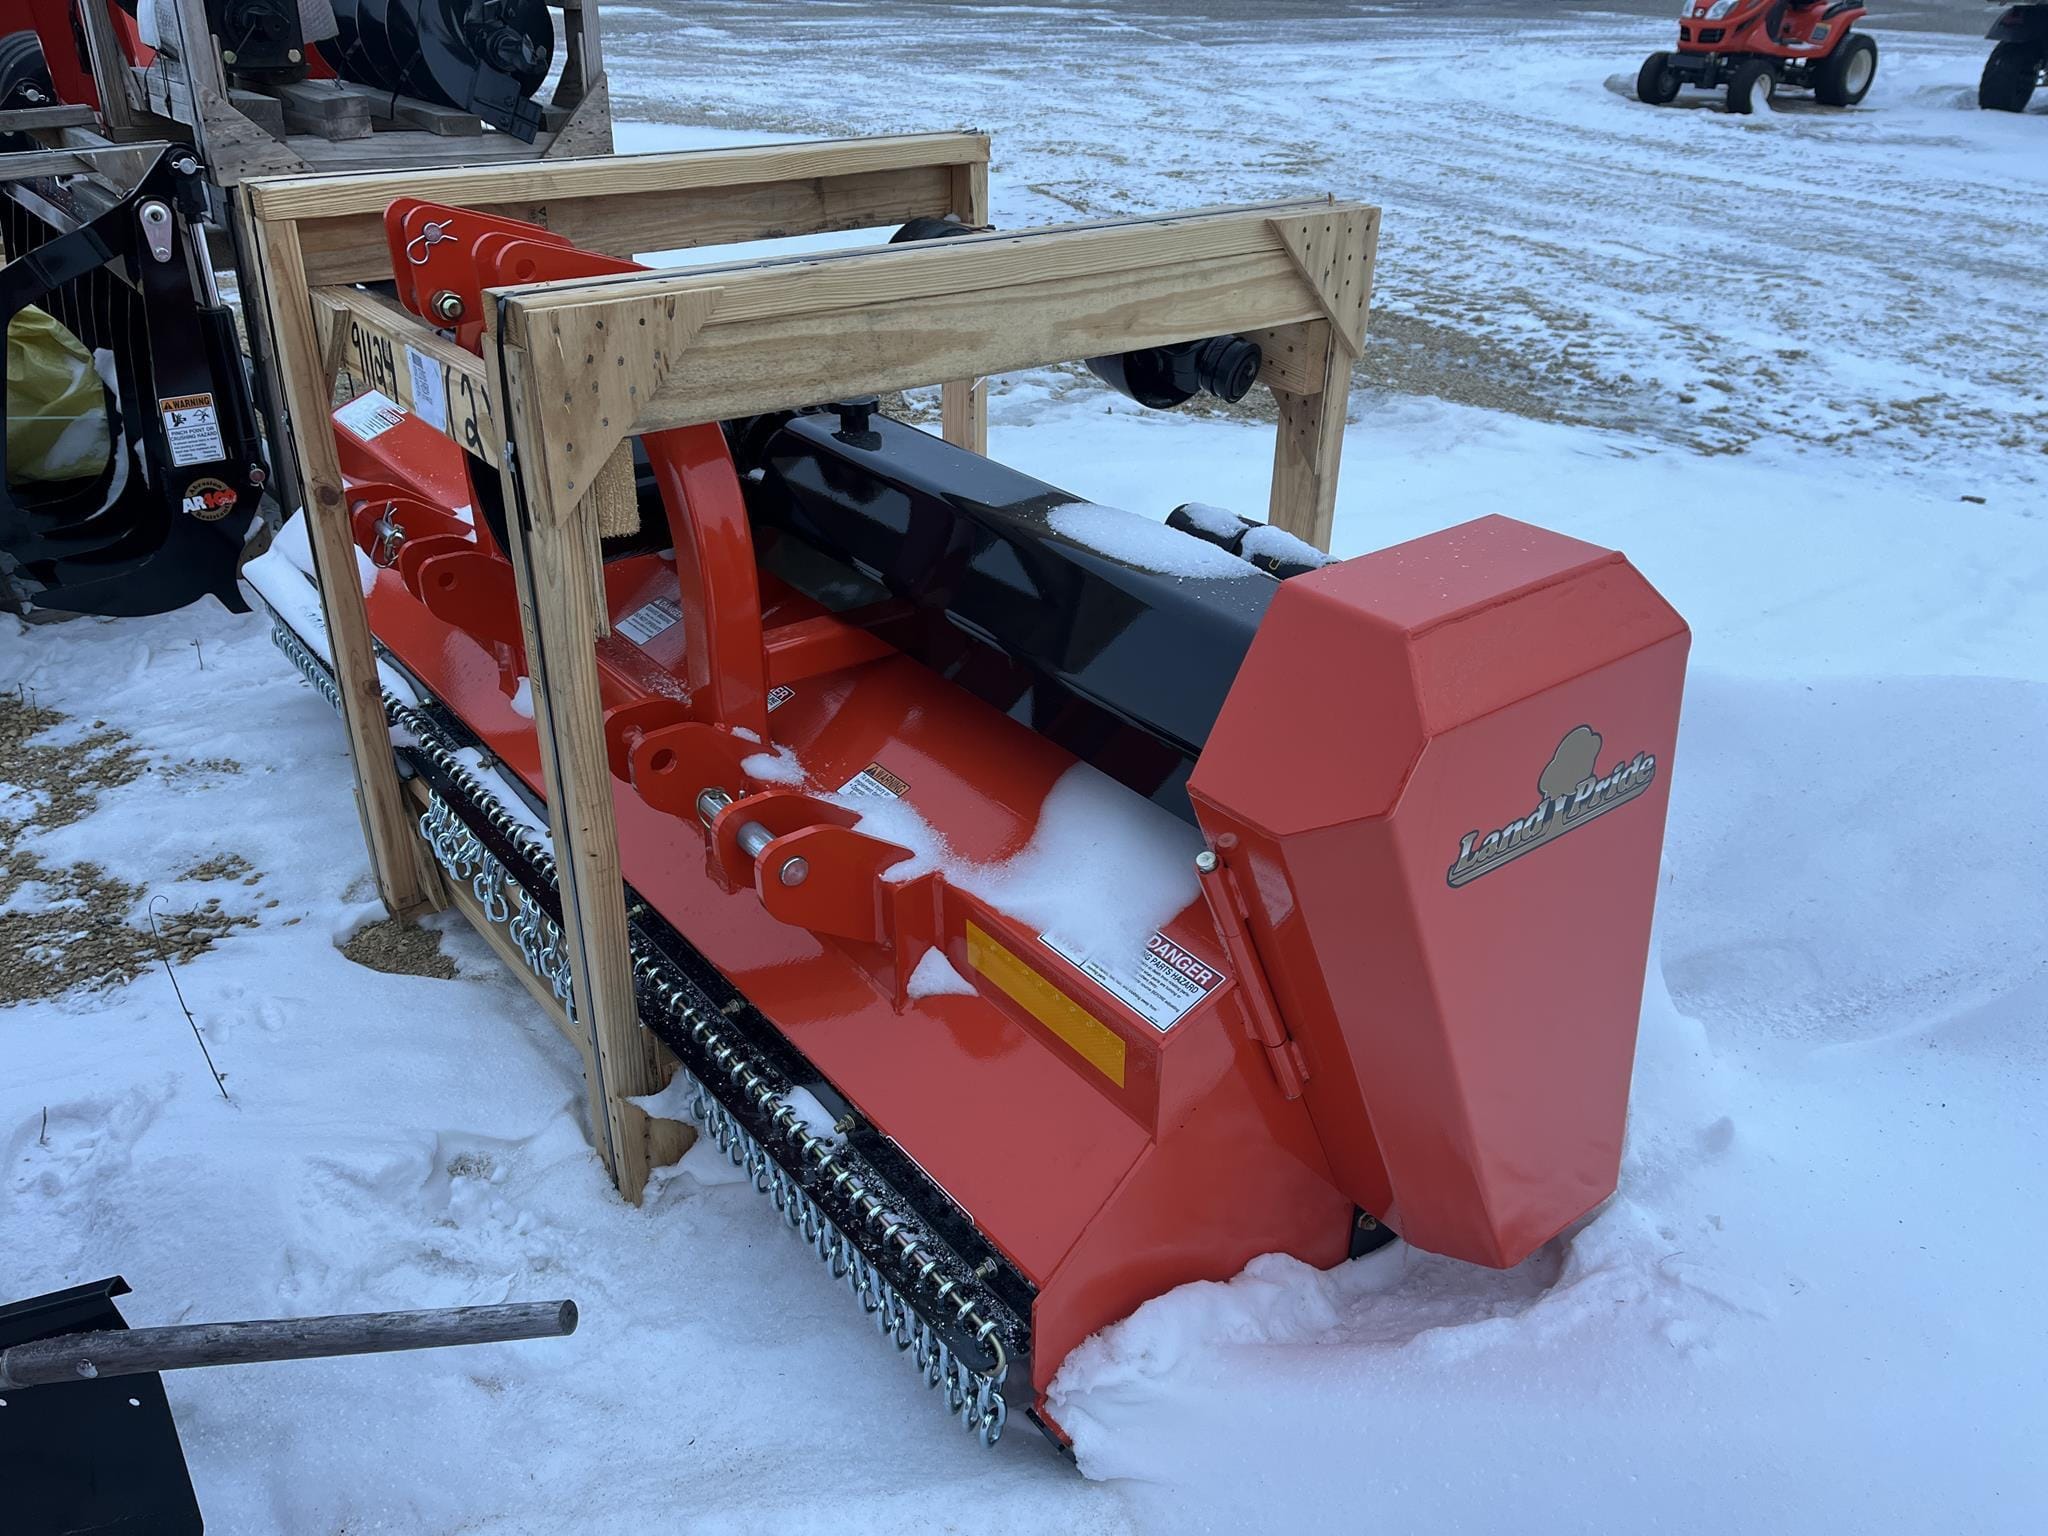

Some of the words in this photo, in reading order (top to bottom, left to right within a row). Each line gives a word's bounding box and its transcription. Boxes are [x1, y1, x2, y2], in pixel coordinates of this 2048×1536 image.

[173, 397, 210, 408] WARNING
[875, 769, 907, 794] WARNING
[1452, 799, 1551, 875] Land
[1567, 751, 1656, 819] Pride
[1145, 935, 1213, 986] DANGER
[1150, 957, 1173, 976] PARTS
[1170, 972, 1199, 994] HAZARD
